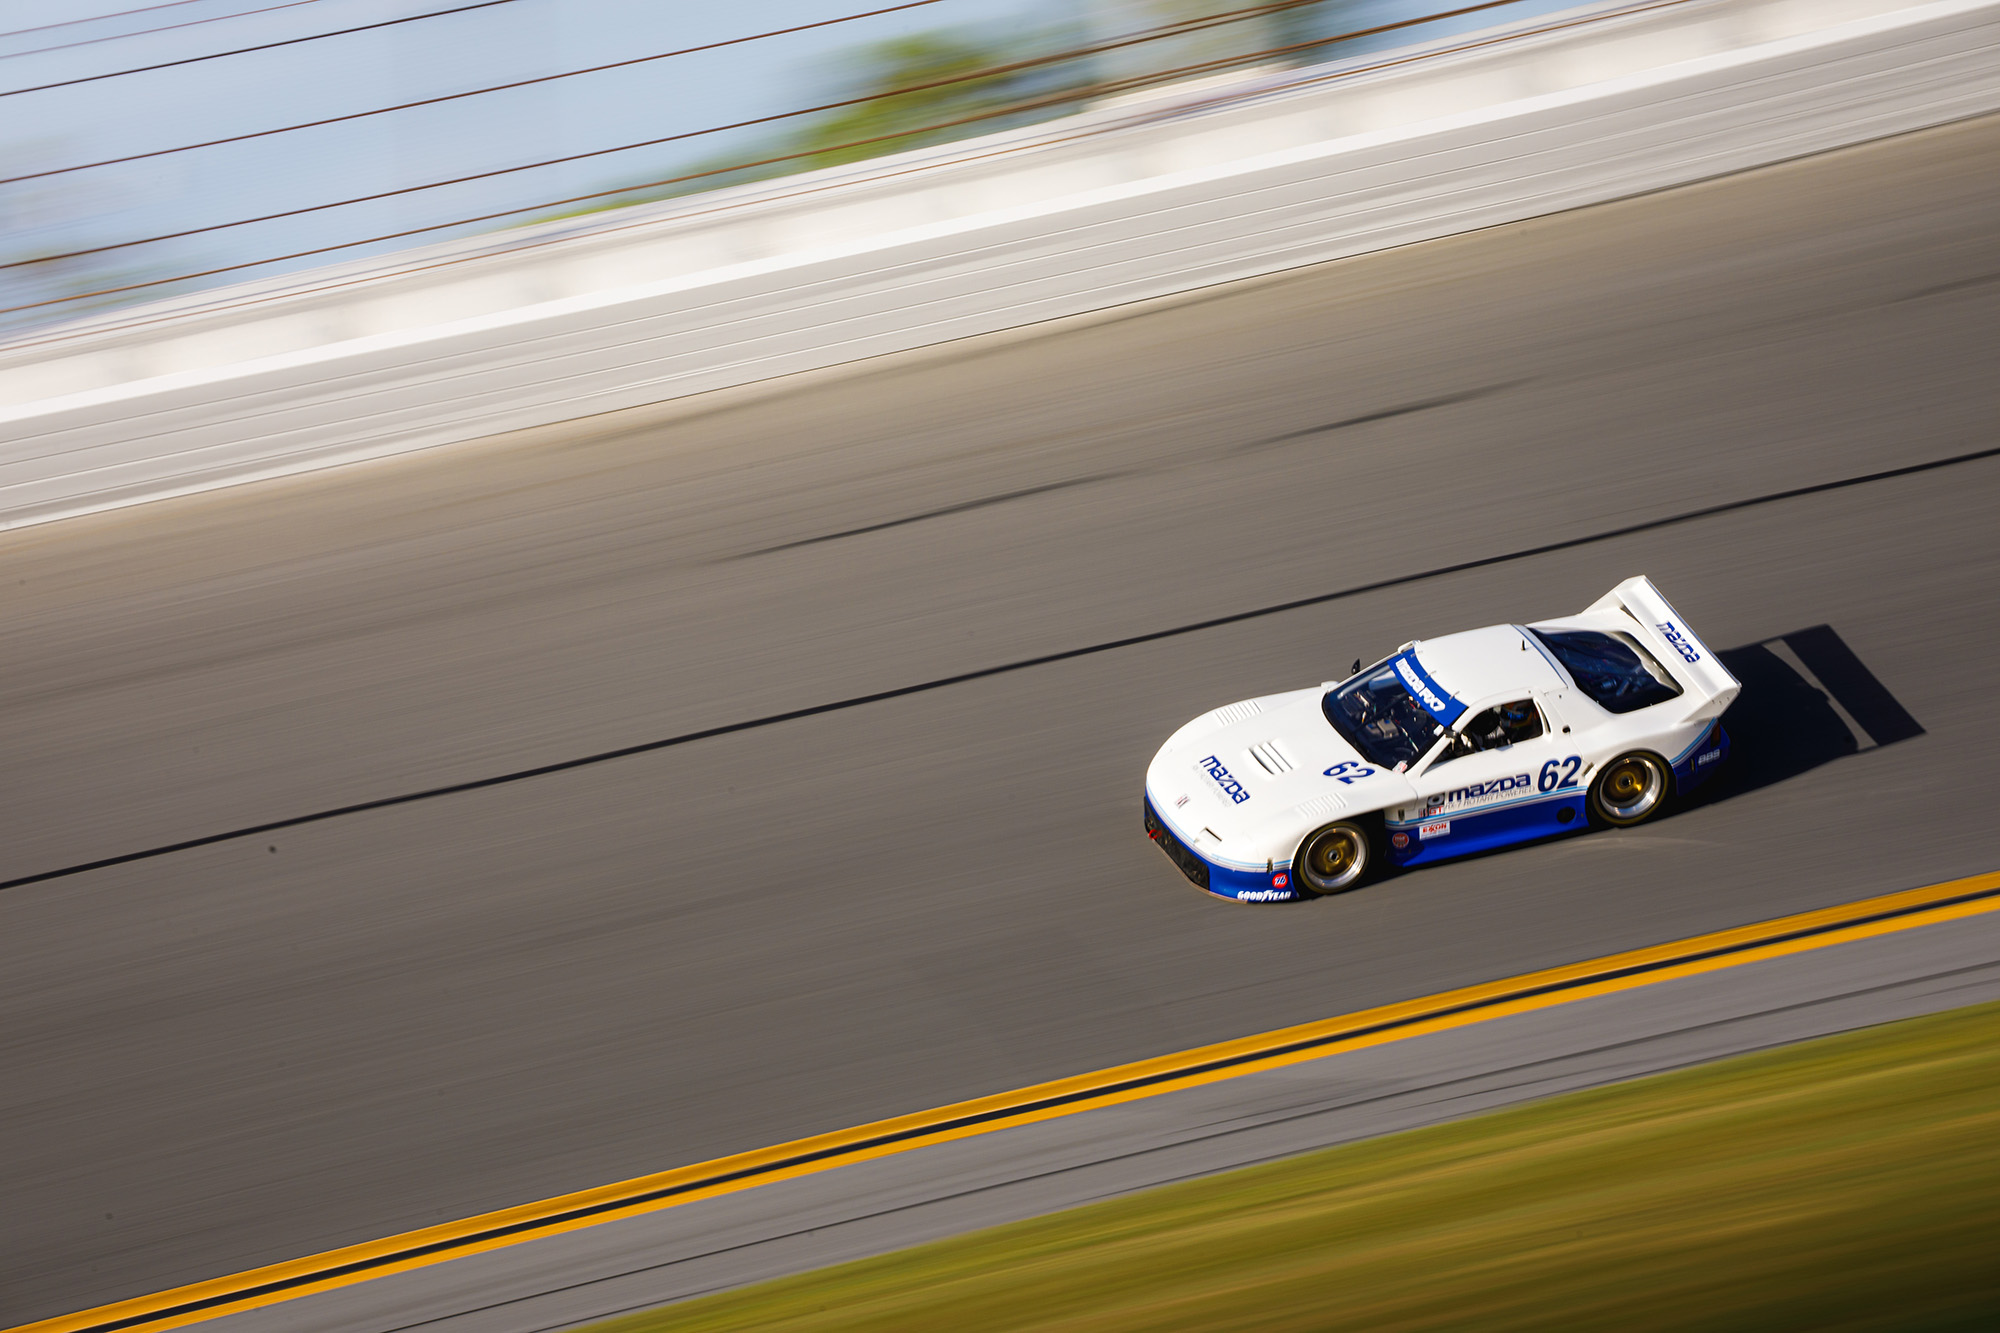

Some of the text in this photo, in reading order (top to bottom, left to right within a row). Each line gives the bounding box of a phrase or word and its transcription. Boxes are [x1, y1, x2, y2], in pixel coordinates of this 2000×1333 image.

[1322, 761, 1376, 784] 62
[1538, 755, 1582, 792] 62
[1422, 821, 1447, 834] EXXON
[1274, 875, 1286, 886] 76
[1237, 889, 1292, 903] GOODYEAR
